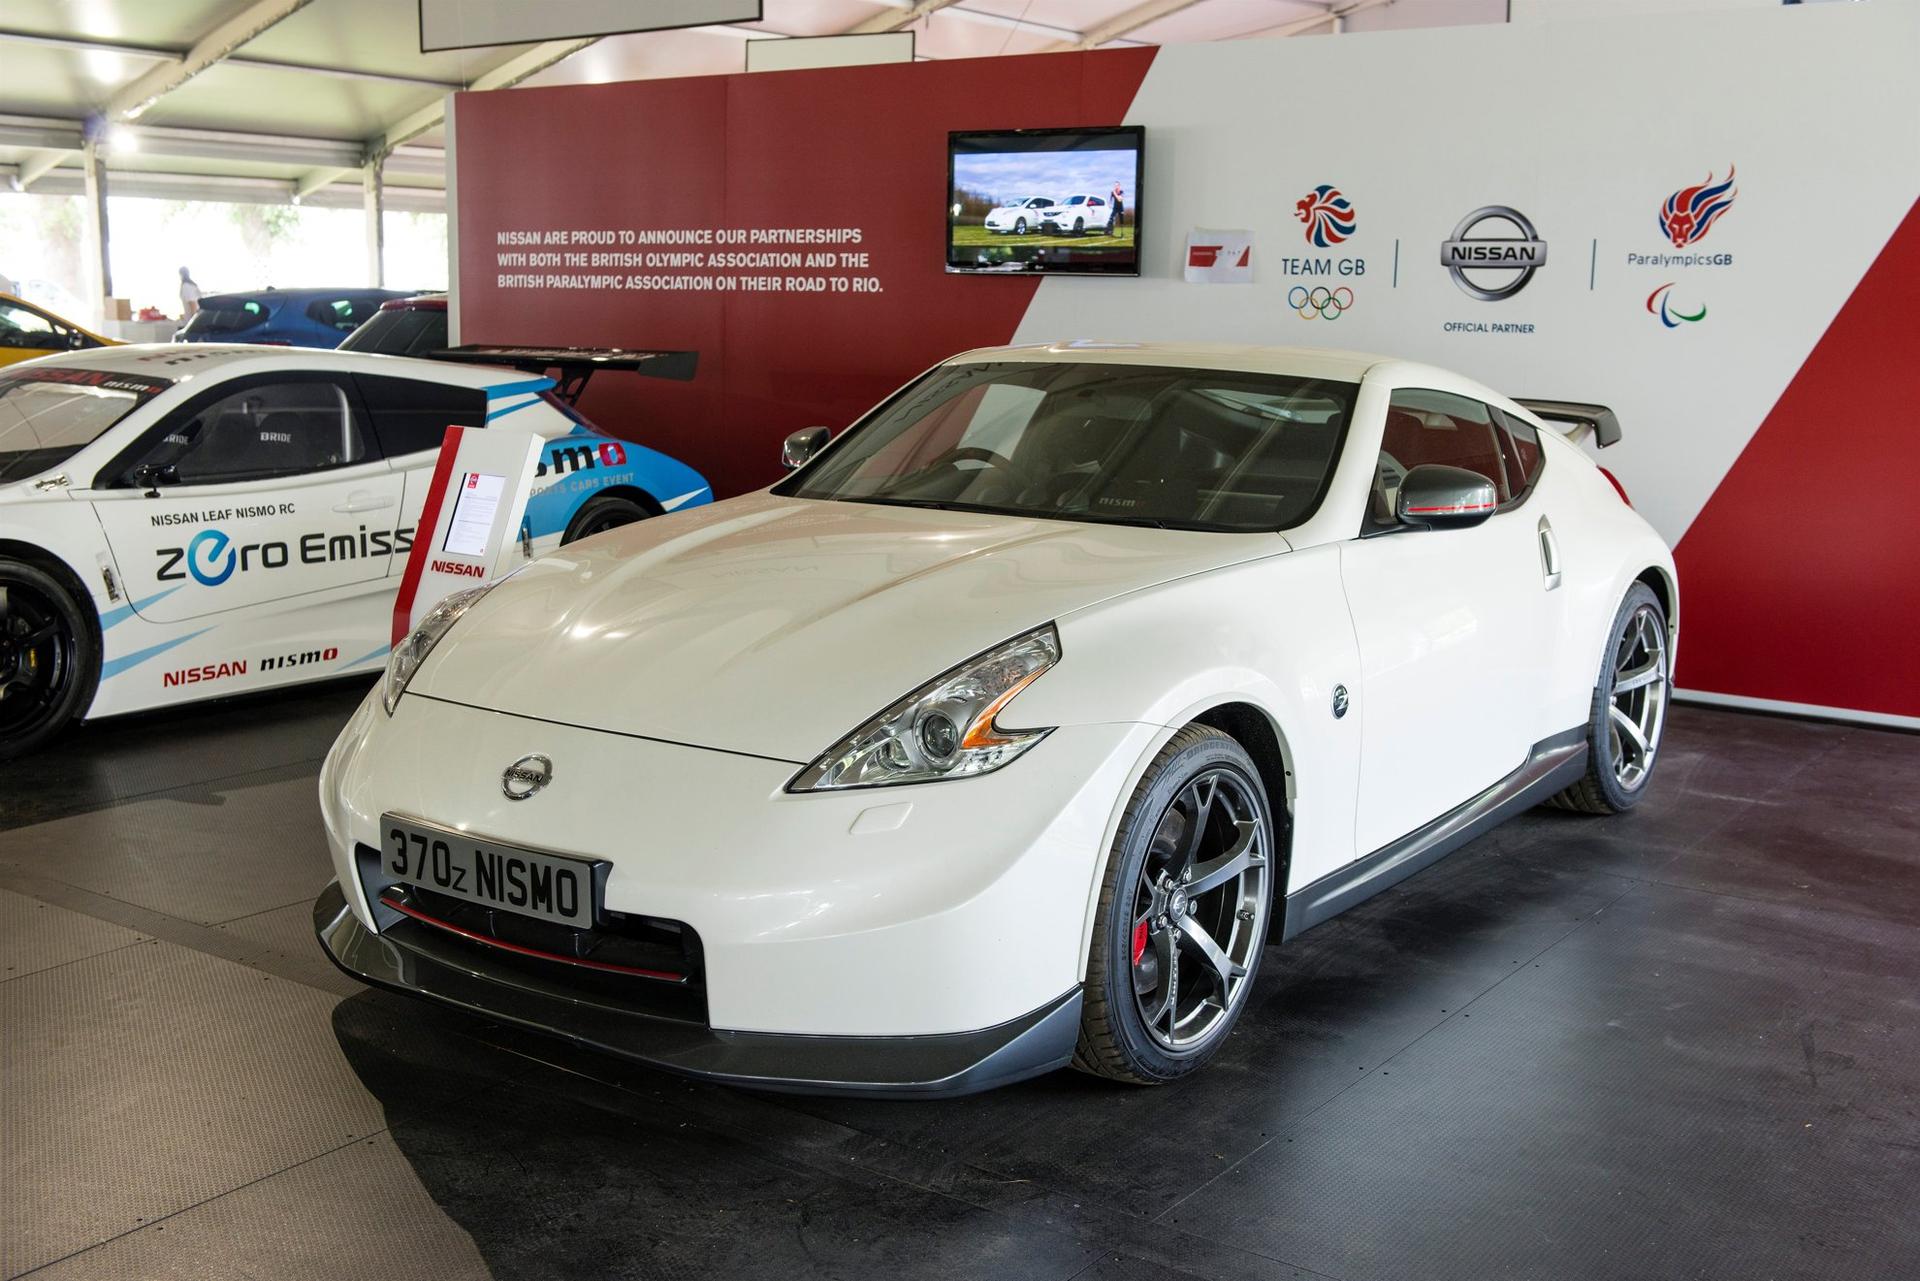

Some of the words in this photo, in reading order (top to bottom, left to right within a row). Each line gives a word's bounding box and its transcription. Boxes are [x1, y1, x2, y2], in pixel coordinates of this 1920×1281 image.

[497, 231, 541, 245] NISSAN
[544, 231, 568, 245] ARE
[571, 230, 616, 245] PROUD
[618, 230, 635, 244] TO
[638, 229, 712, 245] ANNOUNCE
[715, 229, 747, 244] OUR
[750, 228, 862, 244] PARTNERSHIPS
[497, 253, 526, 267] WITH
[529, 253, 561, 267] BOTH
[564, 253, 588, 267] THE
[591, 253, 642, 267] BRITISH
[645, 252, 704, 268] OLYMPIC
[707, 253, 801, 268] ASSOCIATION
[805, 253, 836, 268] AND
[840, 253, 869, 268] THE
[1451, 246, 1536, 260] NISSAN
[1627, 253, 1733, 268] ParalympicsGB
[1281, 258, 1331, 275] TEAM
[1338, 258, 1365, 276] GB
[497, 274, 544, 288] BRITISH
[546, 275, 623, 289] PARALYMPIC
[625, 275, 712, 290] ASSOCIATION
[715, 276, 737, 291] ON
[739, 276, 782, 291] THEIR
[785, 277, 826, 292] ROAD
[829, 277, 849, 292] TO
[852, 277, 884, 293] RIO.
[1443, 322, 1488, 333] OFFICIAL
[1491, 323, 1535, 333] PARTNER
[260, 431, 292, 443] BRIDE
[571, 477, 599, 491] CARS
[603, 472, 634, 486] EVENT
[150, 512, 199, 526] NISSAN
[202, 510, 233, 522] LEAF
[236, 505, 276, 519] NISMO
[279, 503, 295, 514] RC
[430, 560, 485, 578] NISSAN
[163, 659, 247, 688] NISSAN
[260, 647, 338, 671] nismo
[505, 768, 544, 784] NISSAN
[475, 850, 578, 918] NISMO
